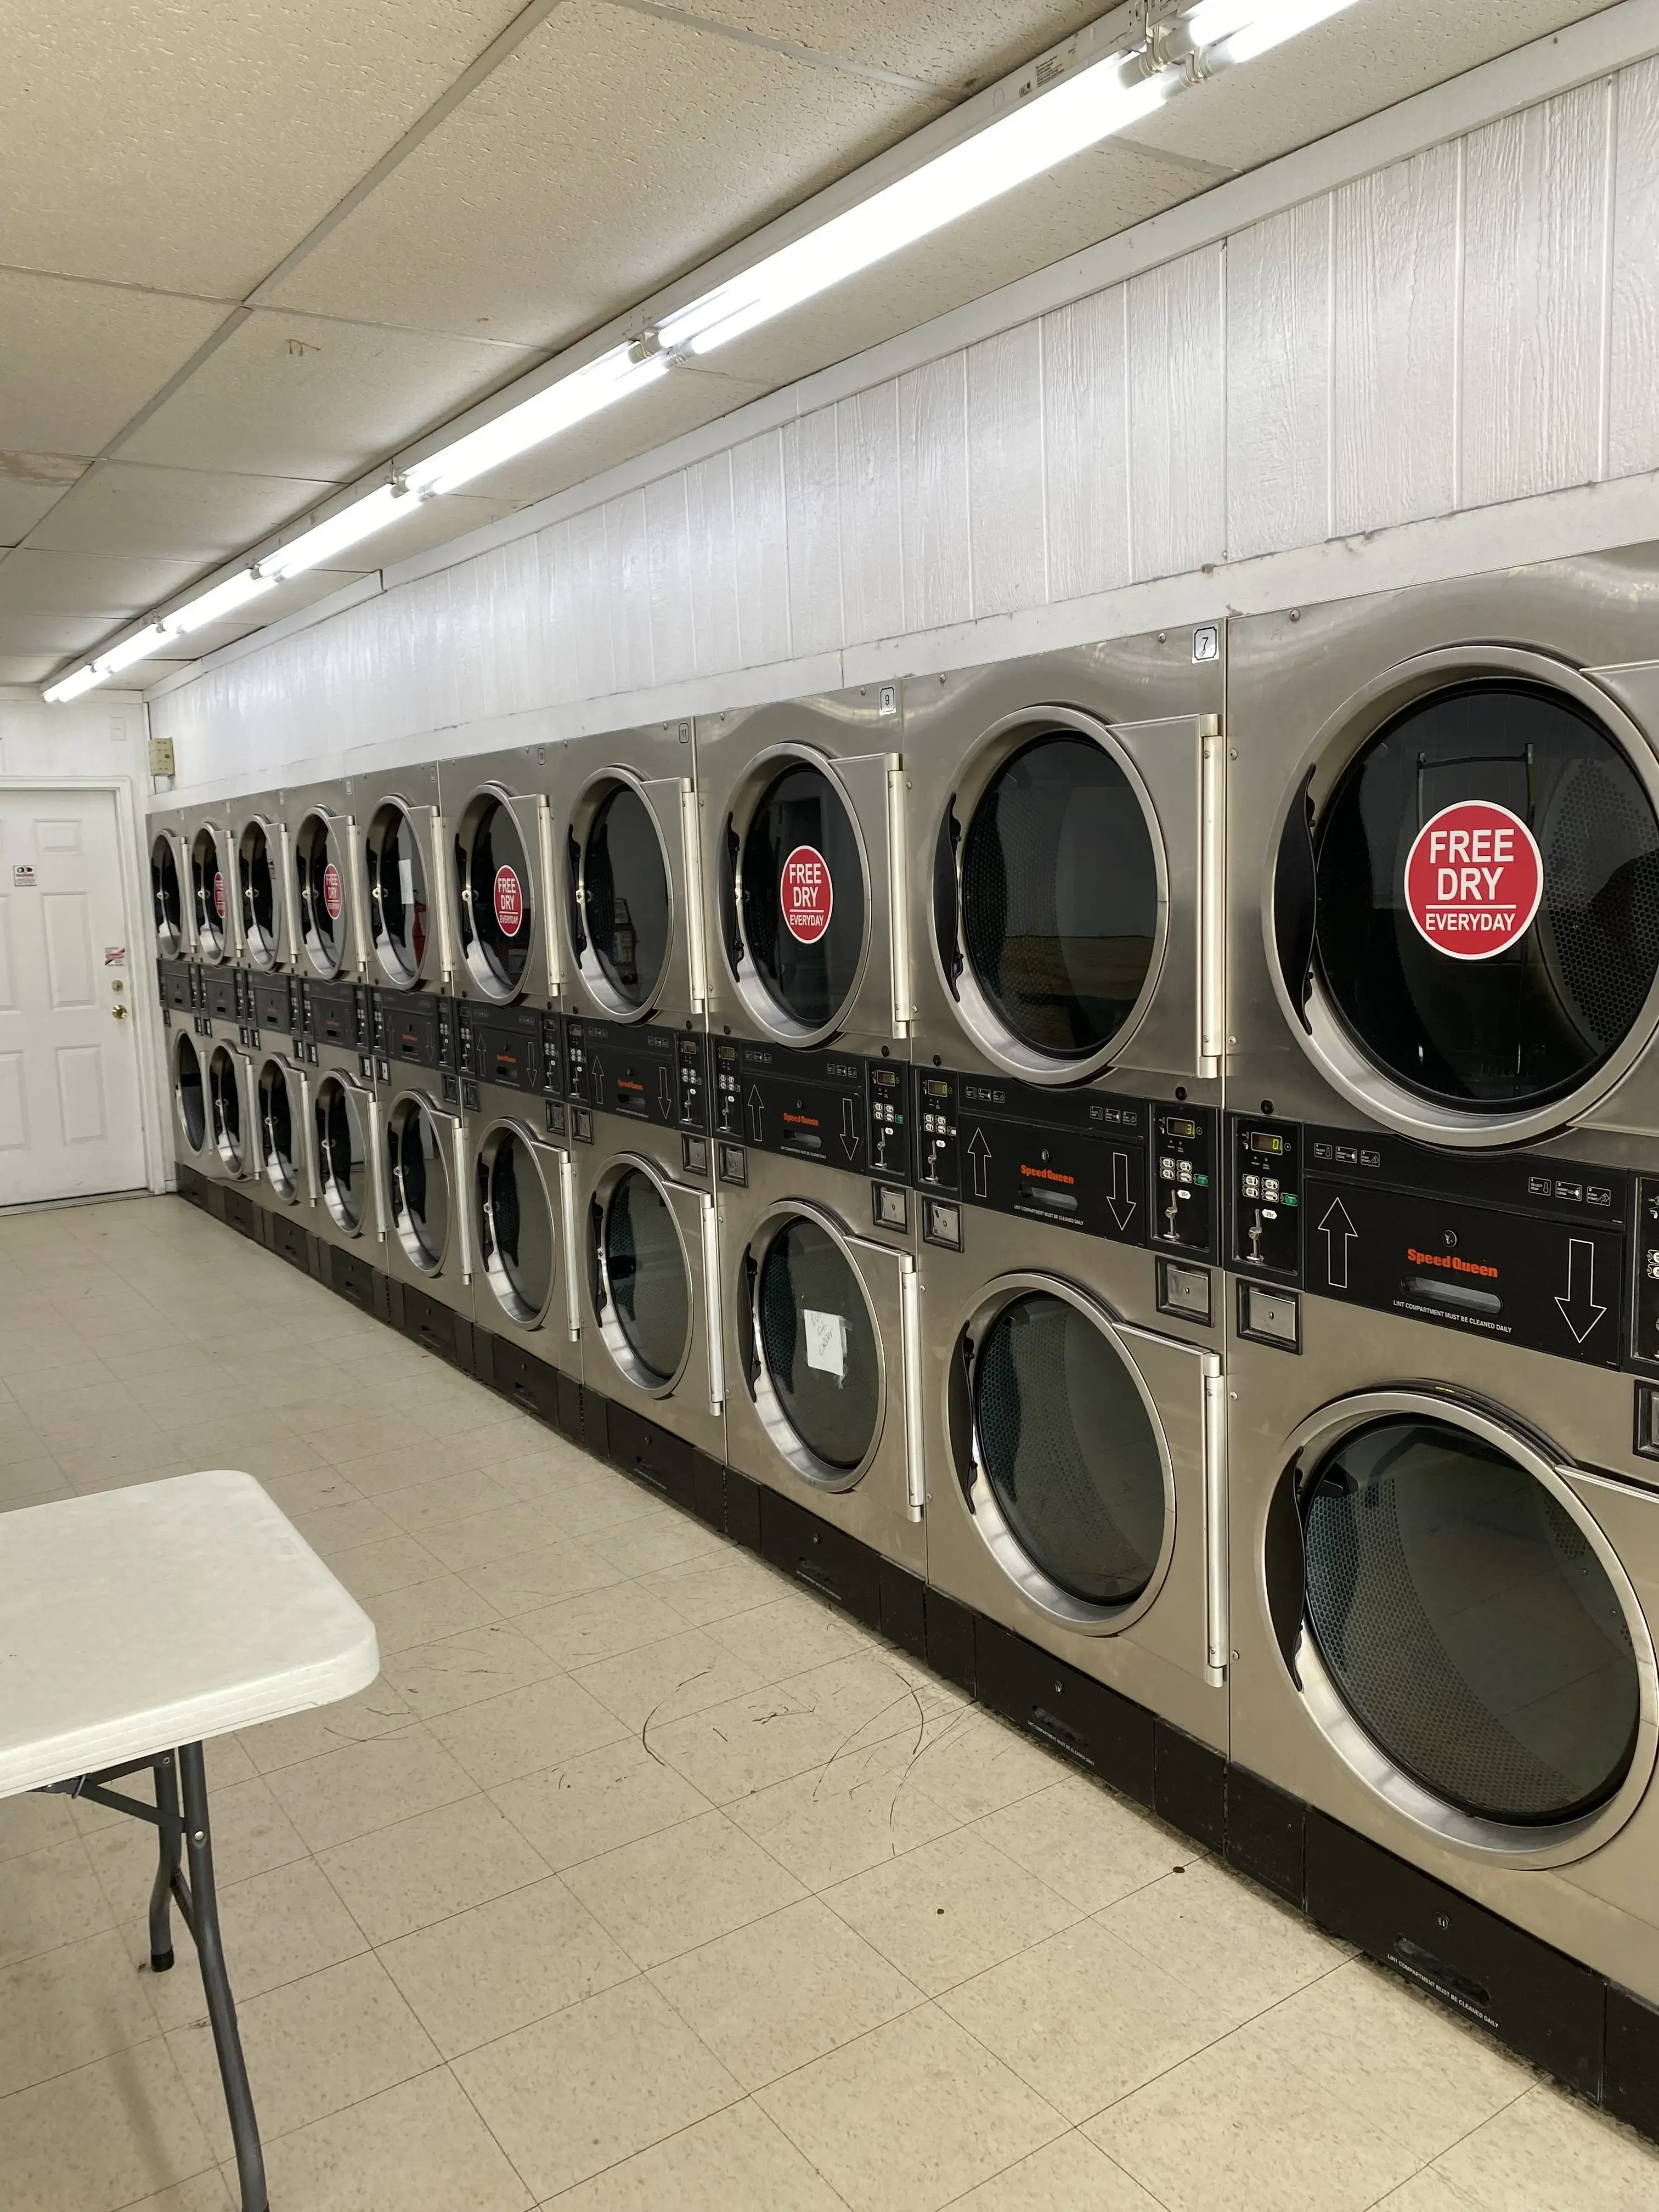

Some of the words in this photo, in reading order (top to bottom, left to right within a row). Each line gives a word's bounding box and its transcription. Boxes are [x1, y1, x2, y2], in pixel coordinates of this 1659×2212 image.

[1202, 636, 1209, 650] 7
[885, 694, 889, 706] 9
[1430, 828, 1515, 864] FREE
[789, 863, 822, 884] FREE
[1437, 867, 1504, 900] DRY
[498, 878, 516, 893] FREE
[500, 895, 515, 910] DRY
[793, 887, 819, 907] DRY
[789, 914, 824, 926] EVERYDAY
[1426, 913, 1516, 931] EVERYDAY
[1021, 1164, 1047, 1178] Speed
[1047, 1170, 1074, 1184] Queen
[1407, 1249, 1451, 1268] Speed
[1452, 1257, 1498, 1278] Queen
[1405, 1302, 1444, 1317] COMPARTMENT
[1445, 1312, 1460, 1321] MUST
[1469, 1318, 1495, 1329] CLEANED
[1496, 1324, 1512, 1333] DAILY
[1387, 1953, 1398, 1963] LINT
[1398, 1960, 1435, 1988] COMPARTMENT
[1436, 1984, 1450, 1997] MUST
[1451, 1994, 1458, 2002] BE
[1459, 2000, 1483, 2018] CLEANED
[1483, 2015, 1499, 2028] DAILY
